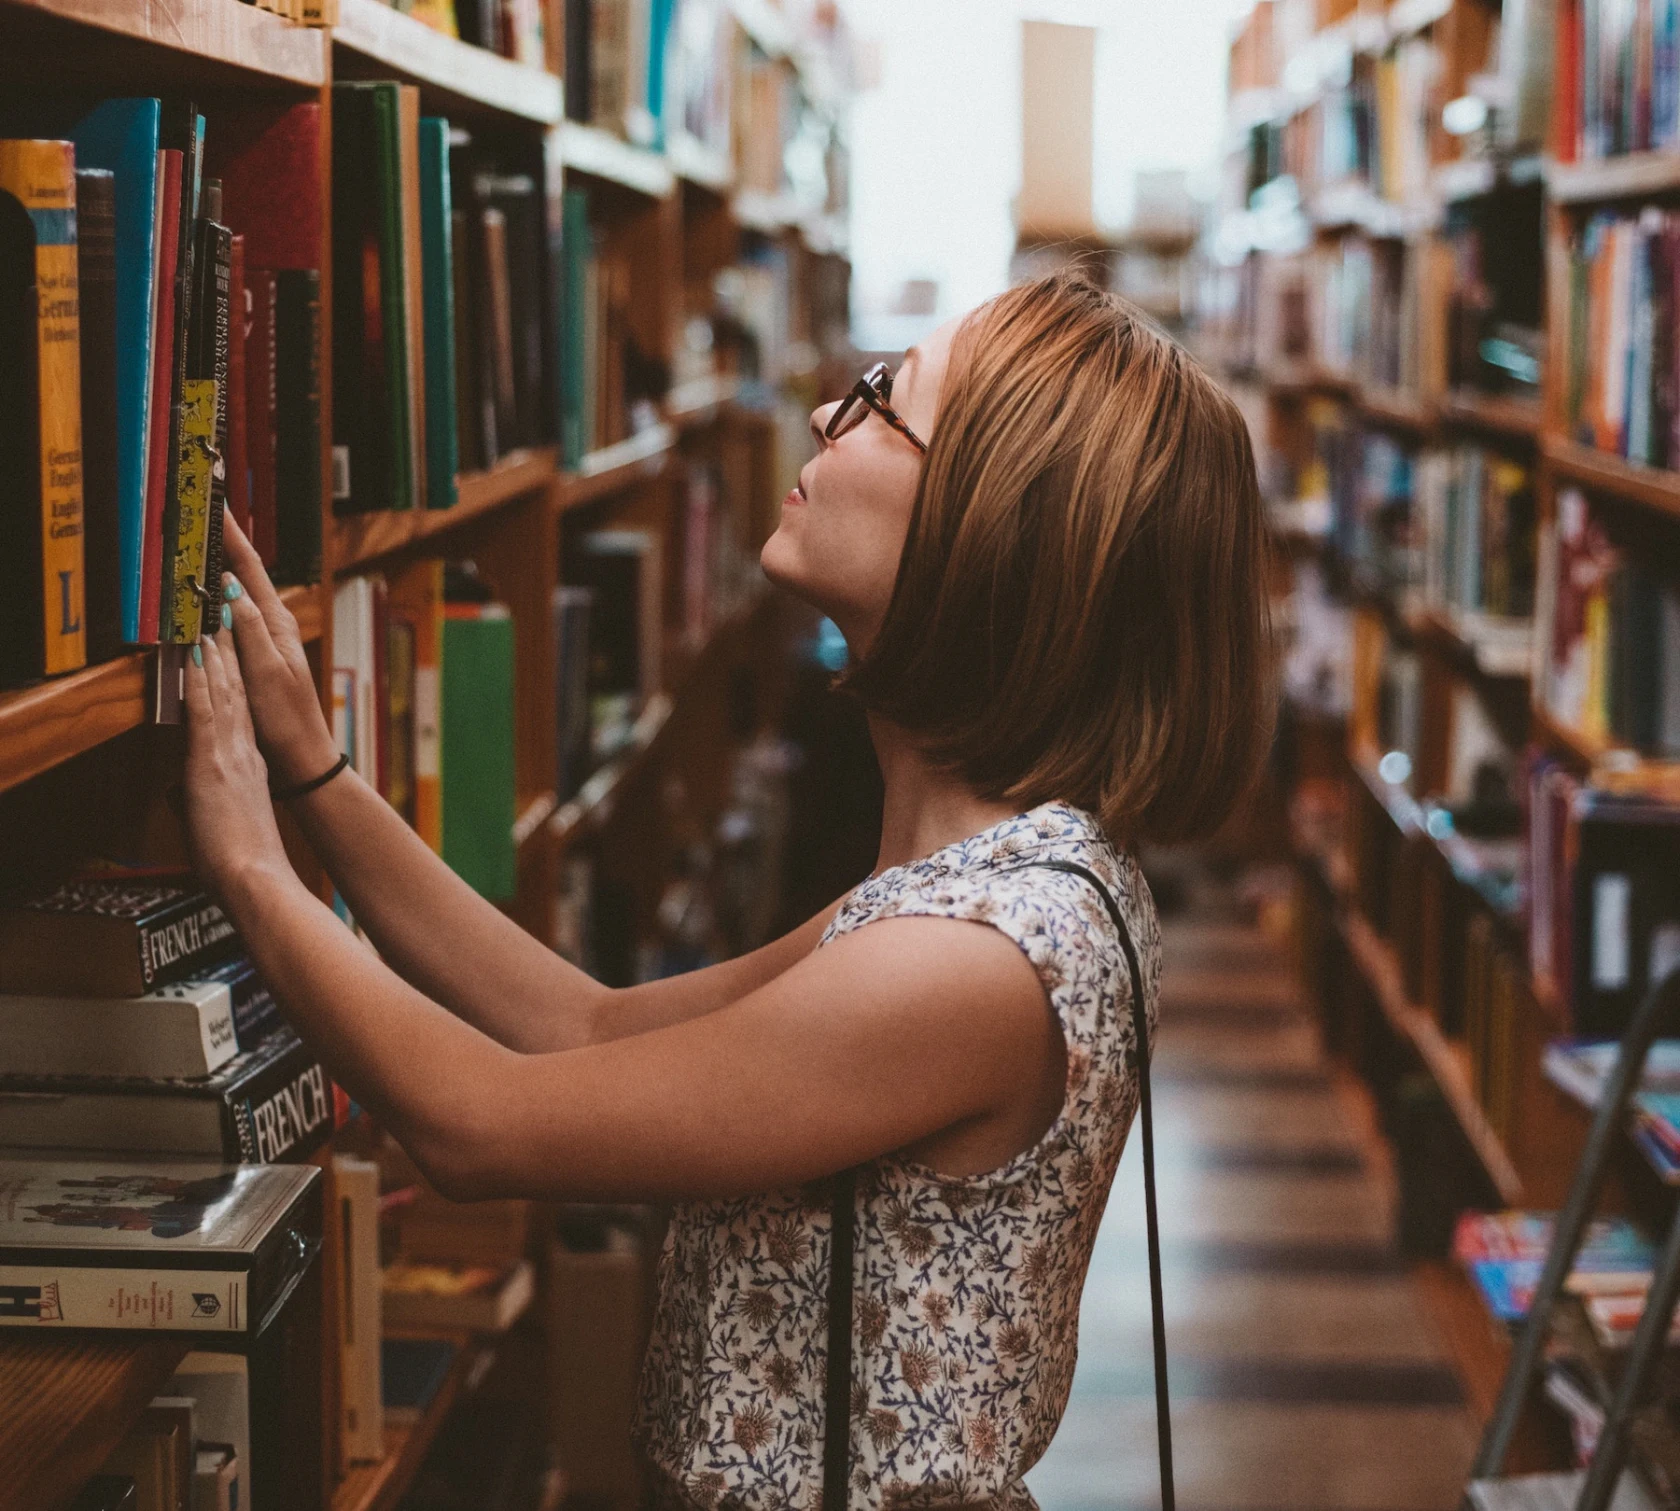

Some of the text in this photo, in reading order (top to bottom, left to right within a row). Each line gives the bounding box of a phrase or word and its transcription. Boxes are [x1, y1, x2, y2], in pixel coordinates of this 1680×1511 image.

[219, 297, 229, 422] GERMAN-ENGLISH
[58, 570, 81, 636] L
[140, 928, 154, 984] Oxford
[150, 914, 203, 970] FRENCH
[253, 1063, 328, 1164] FRENCH
[36, 1283, 60, 1322] Plus
